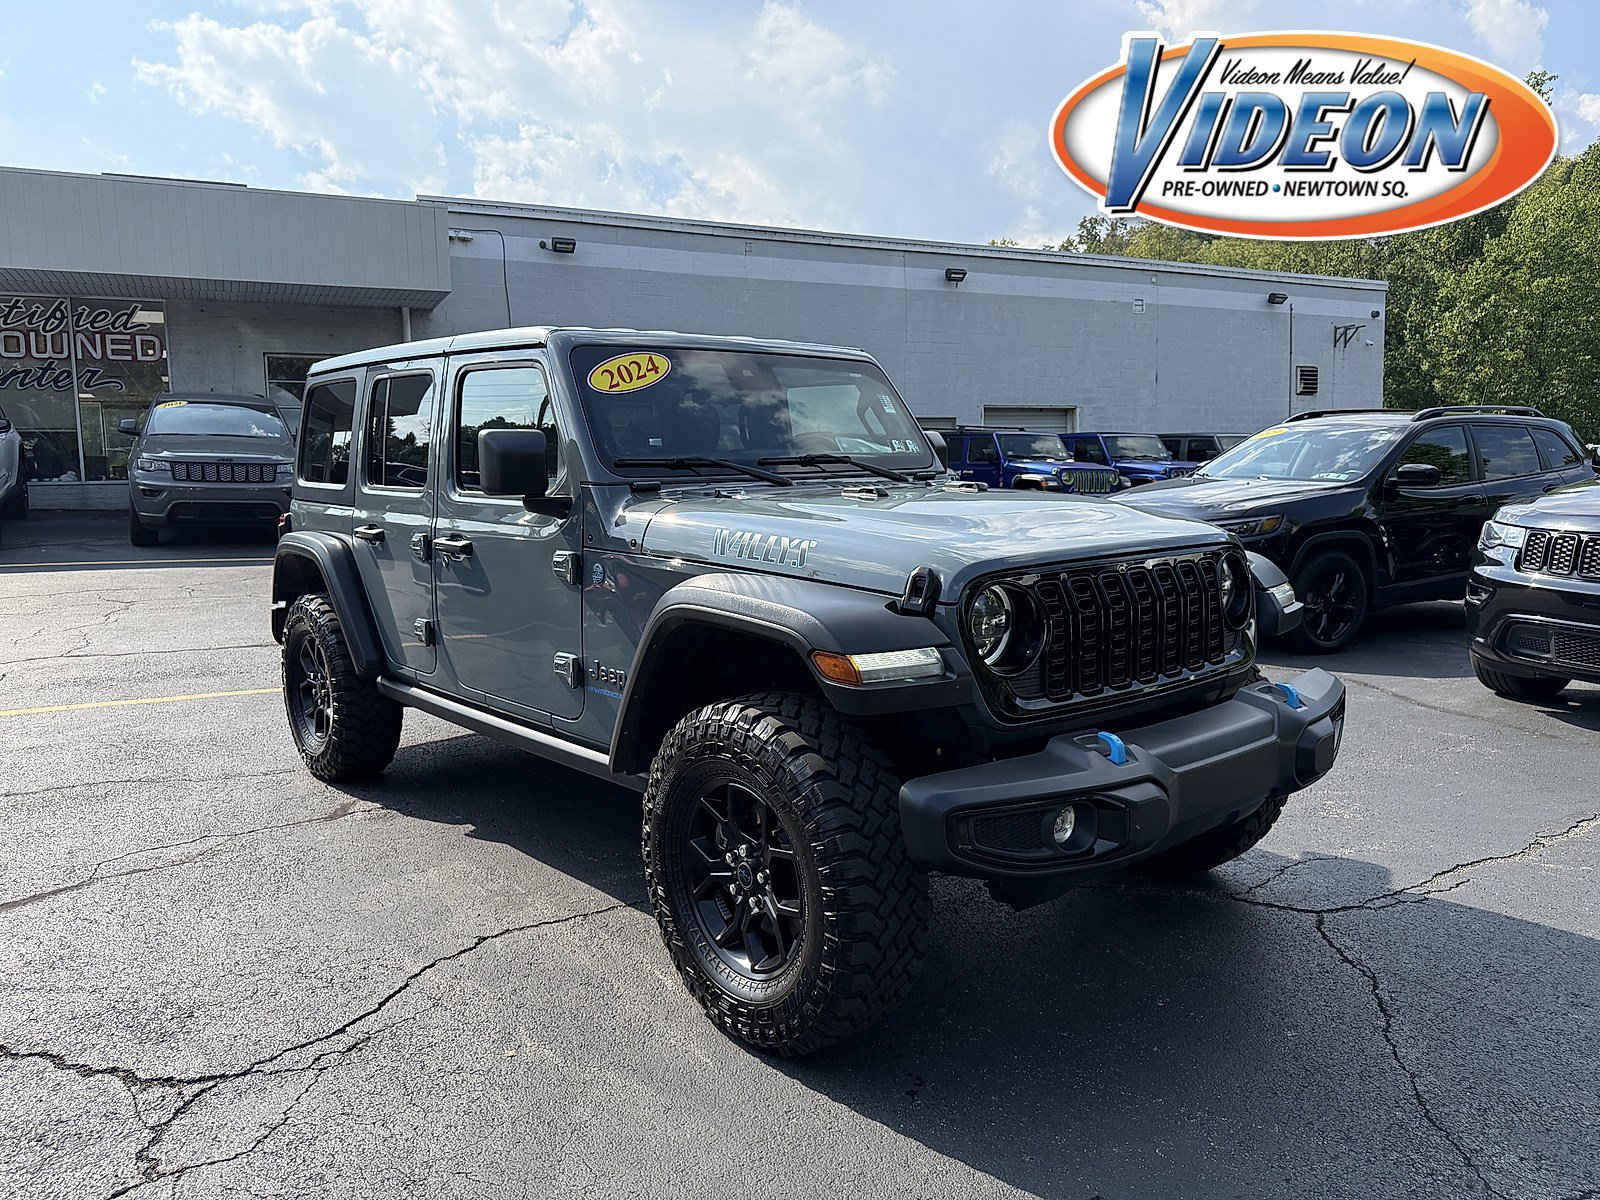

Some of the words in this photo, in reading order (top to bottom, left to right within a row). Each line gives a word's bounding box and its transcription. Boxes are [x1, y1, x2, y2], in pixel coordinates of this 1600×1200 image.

[0, 297, 150, 335] tified
[0, 330, 162, 361] OWNED
[600, 355, 660, 391] 2024
[712, 528, 818, 568] WILLYS
[588, 659, 628, 691] Jeep
